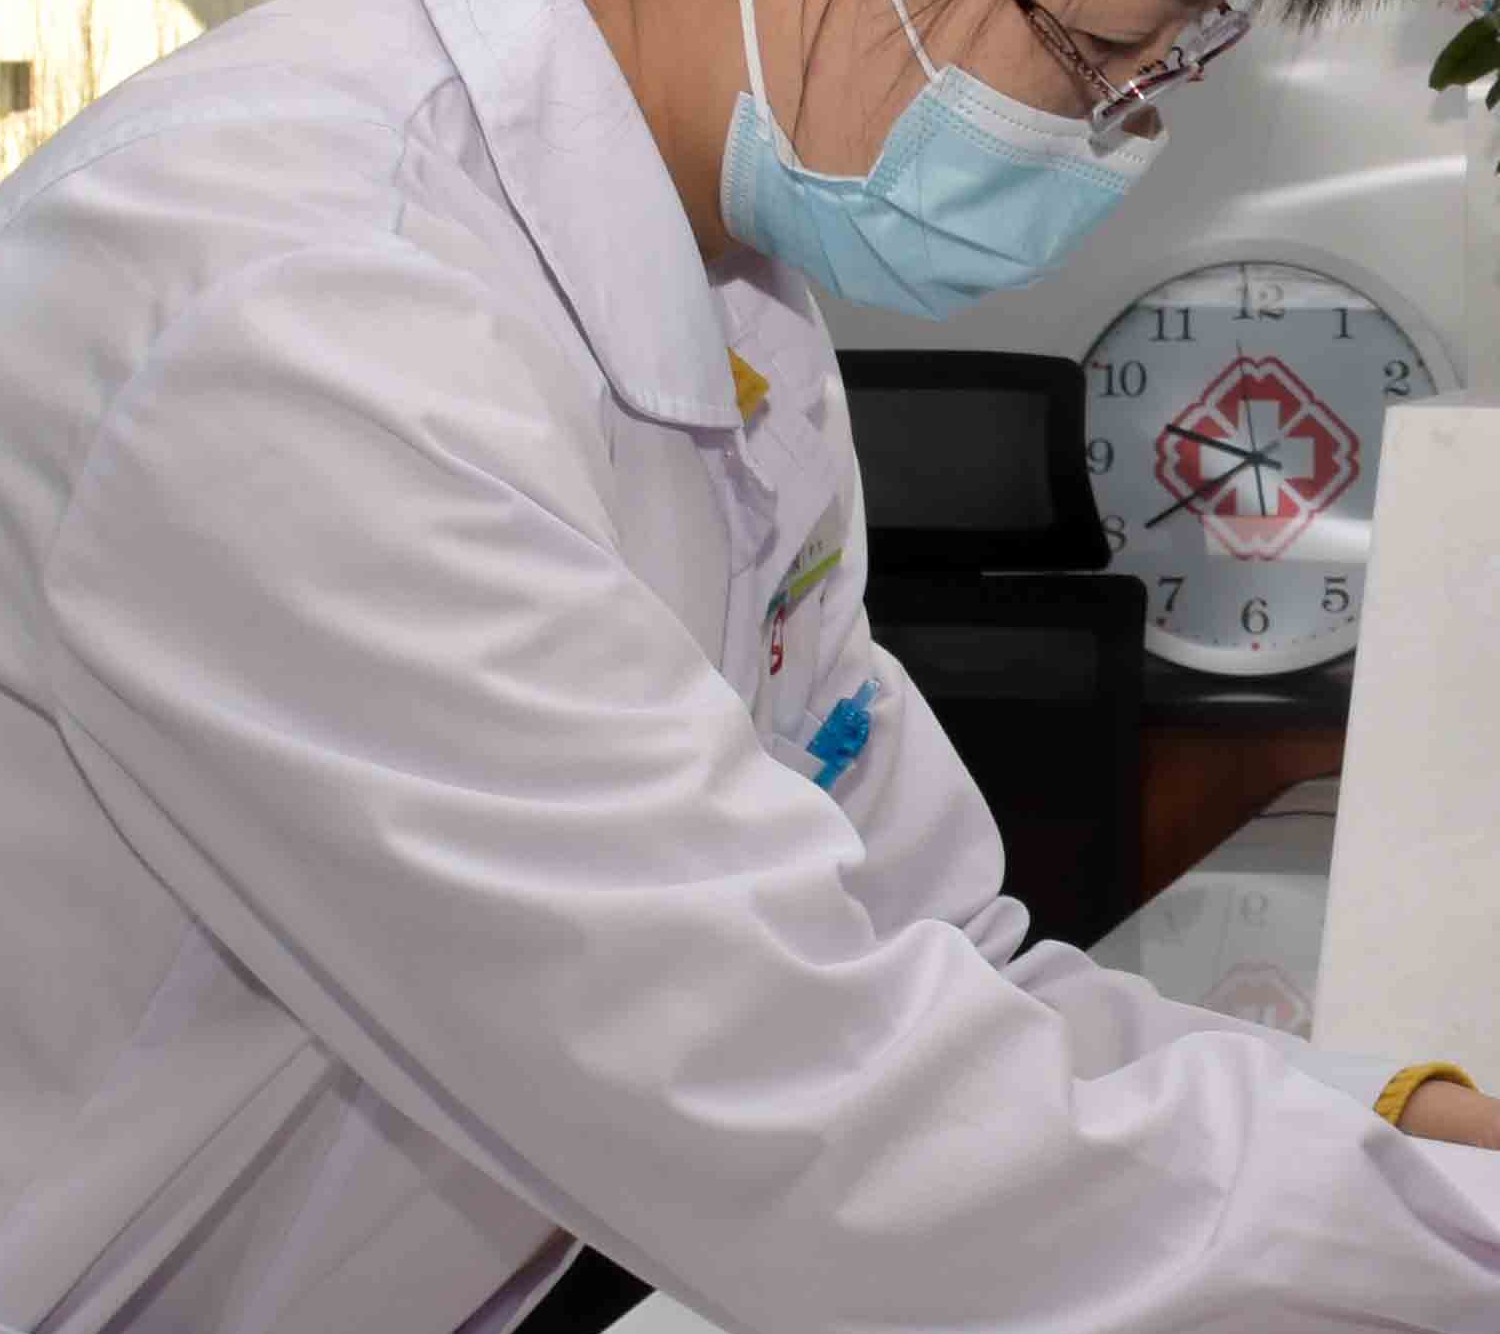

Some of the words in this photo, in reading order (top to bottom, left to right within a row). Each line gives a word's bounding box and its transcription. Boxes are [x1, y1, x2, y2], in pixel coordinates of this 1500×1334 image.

[1232, 284, 1284, 321] 12
[1150, 308, 1195, 342] 11
[1333, 307, 1352, 340] 1
[1100, 362, 1147, 396] 10
[1384, 361, 1411, 396] 2
[1088, 438, 1114, 474] 9
[1103, 515, 1127, 553] 8
[1157, 577, 1184, 613] 7
[1322, 577, 1350, 613] 5
[1241, 598, 1269, 635] 6
